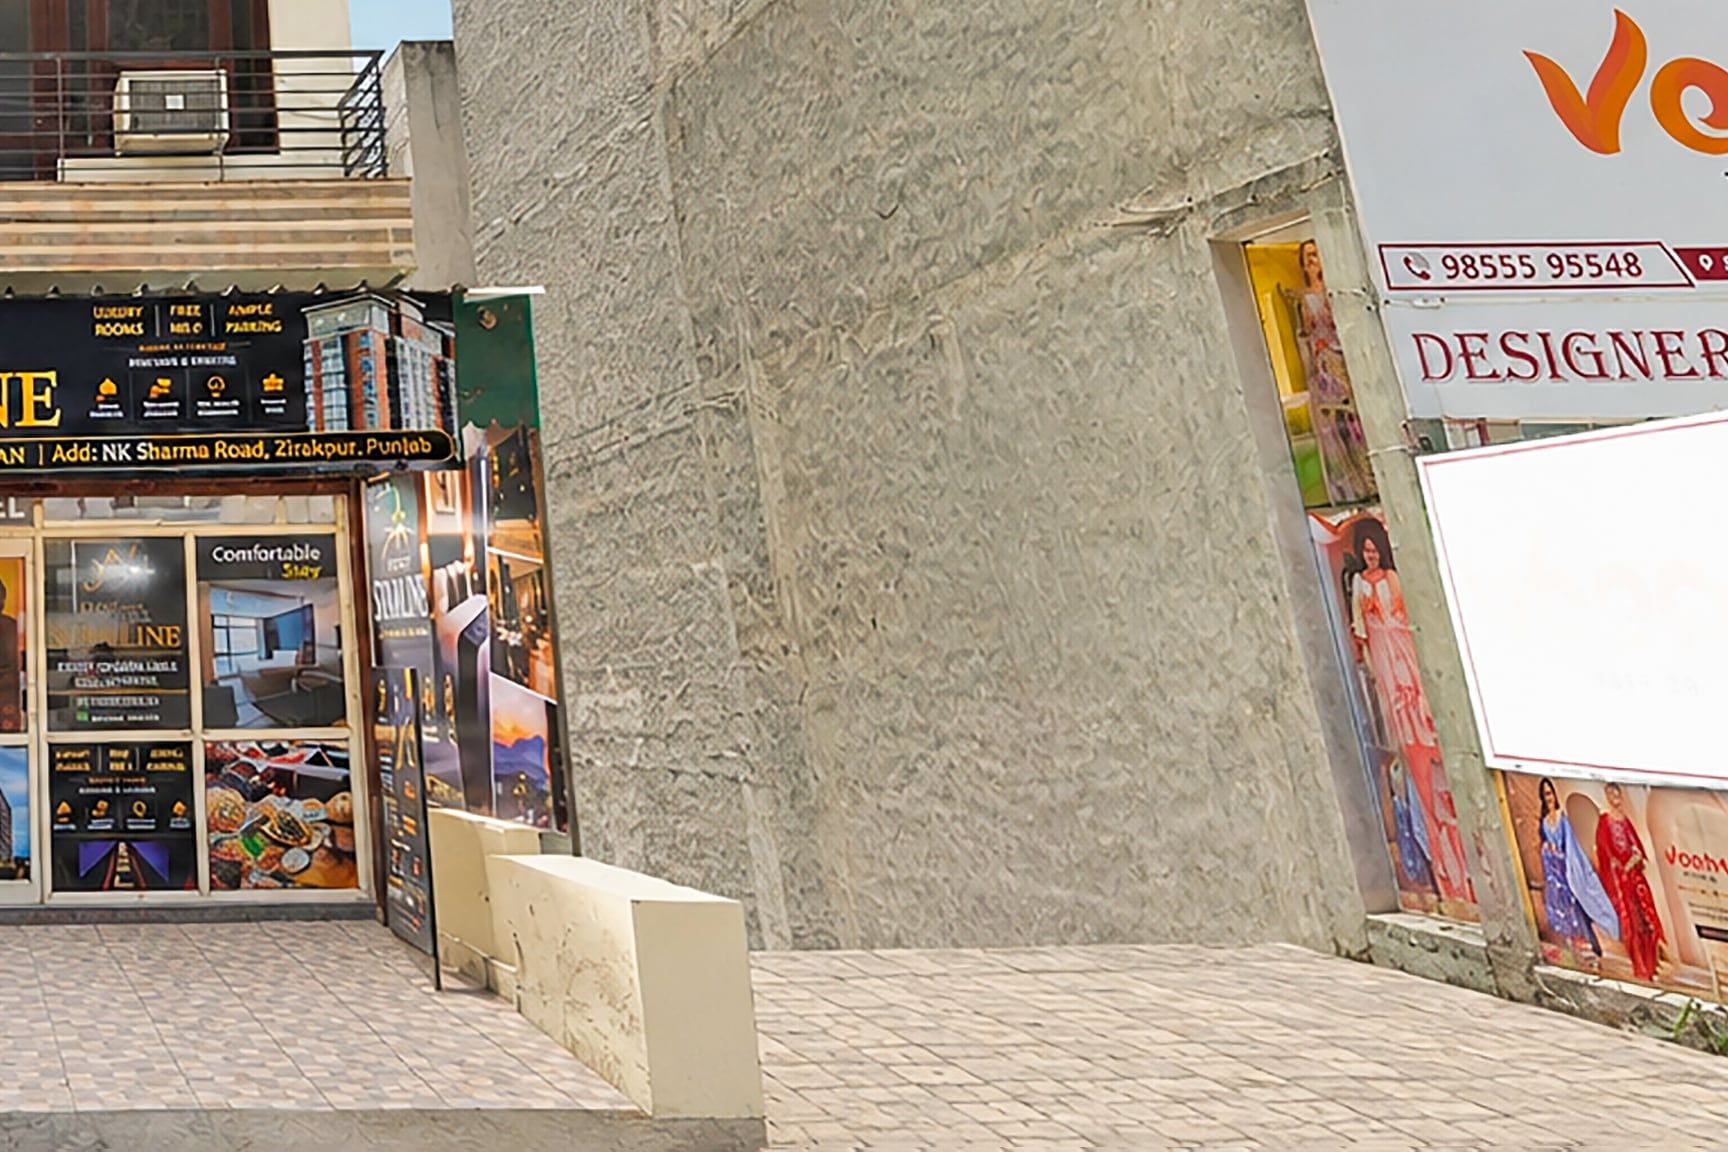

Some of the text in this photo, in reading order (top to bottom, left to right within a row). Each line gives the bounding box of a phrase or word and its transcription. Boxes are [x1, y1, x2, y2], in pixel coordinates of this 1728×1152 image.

[1440, 251, 1643, 280] 98555 95548
[1411, 328, 1728, 383] DESIGNER
[51, 443, 98, 463] Add:
[102, 443, 132, 461] NK
[135, 441, 210, 461] Sharma
[214, 440, 270, 461] Road,
[212, 543, 322, 563] Comfortable
